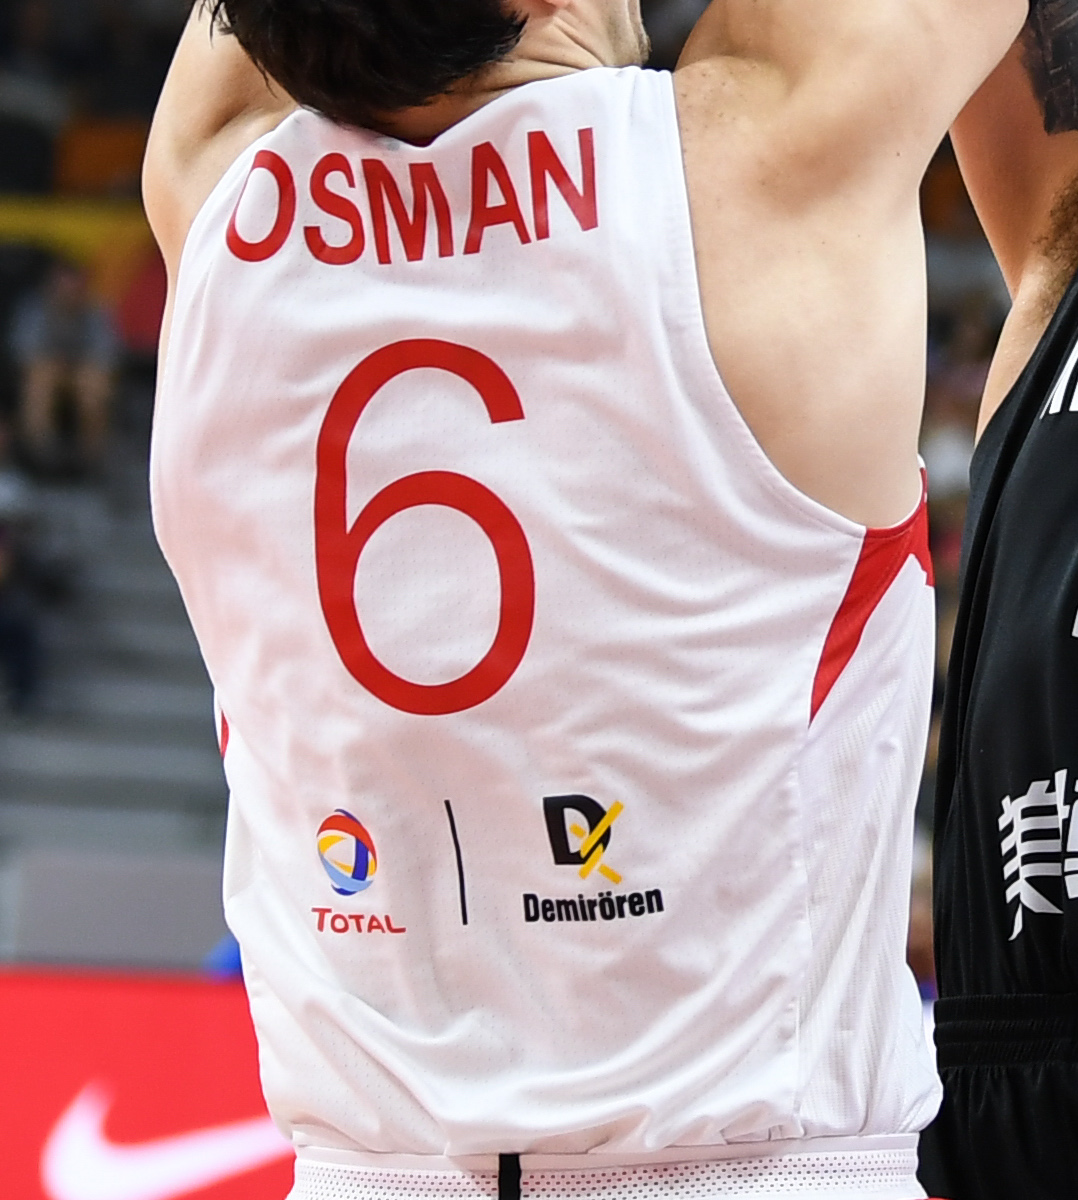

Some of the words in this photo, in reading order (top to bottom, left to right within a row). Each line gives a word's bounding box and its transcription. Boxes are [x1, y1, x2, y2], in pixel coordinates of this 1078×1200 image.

[226, 126, 599, 266] OSMAN
[314, 338, 536, 716] 6
[311, 907, 407, 934] TOTAL
[523, 888, 665, 923] Demirören
